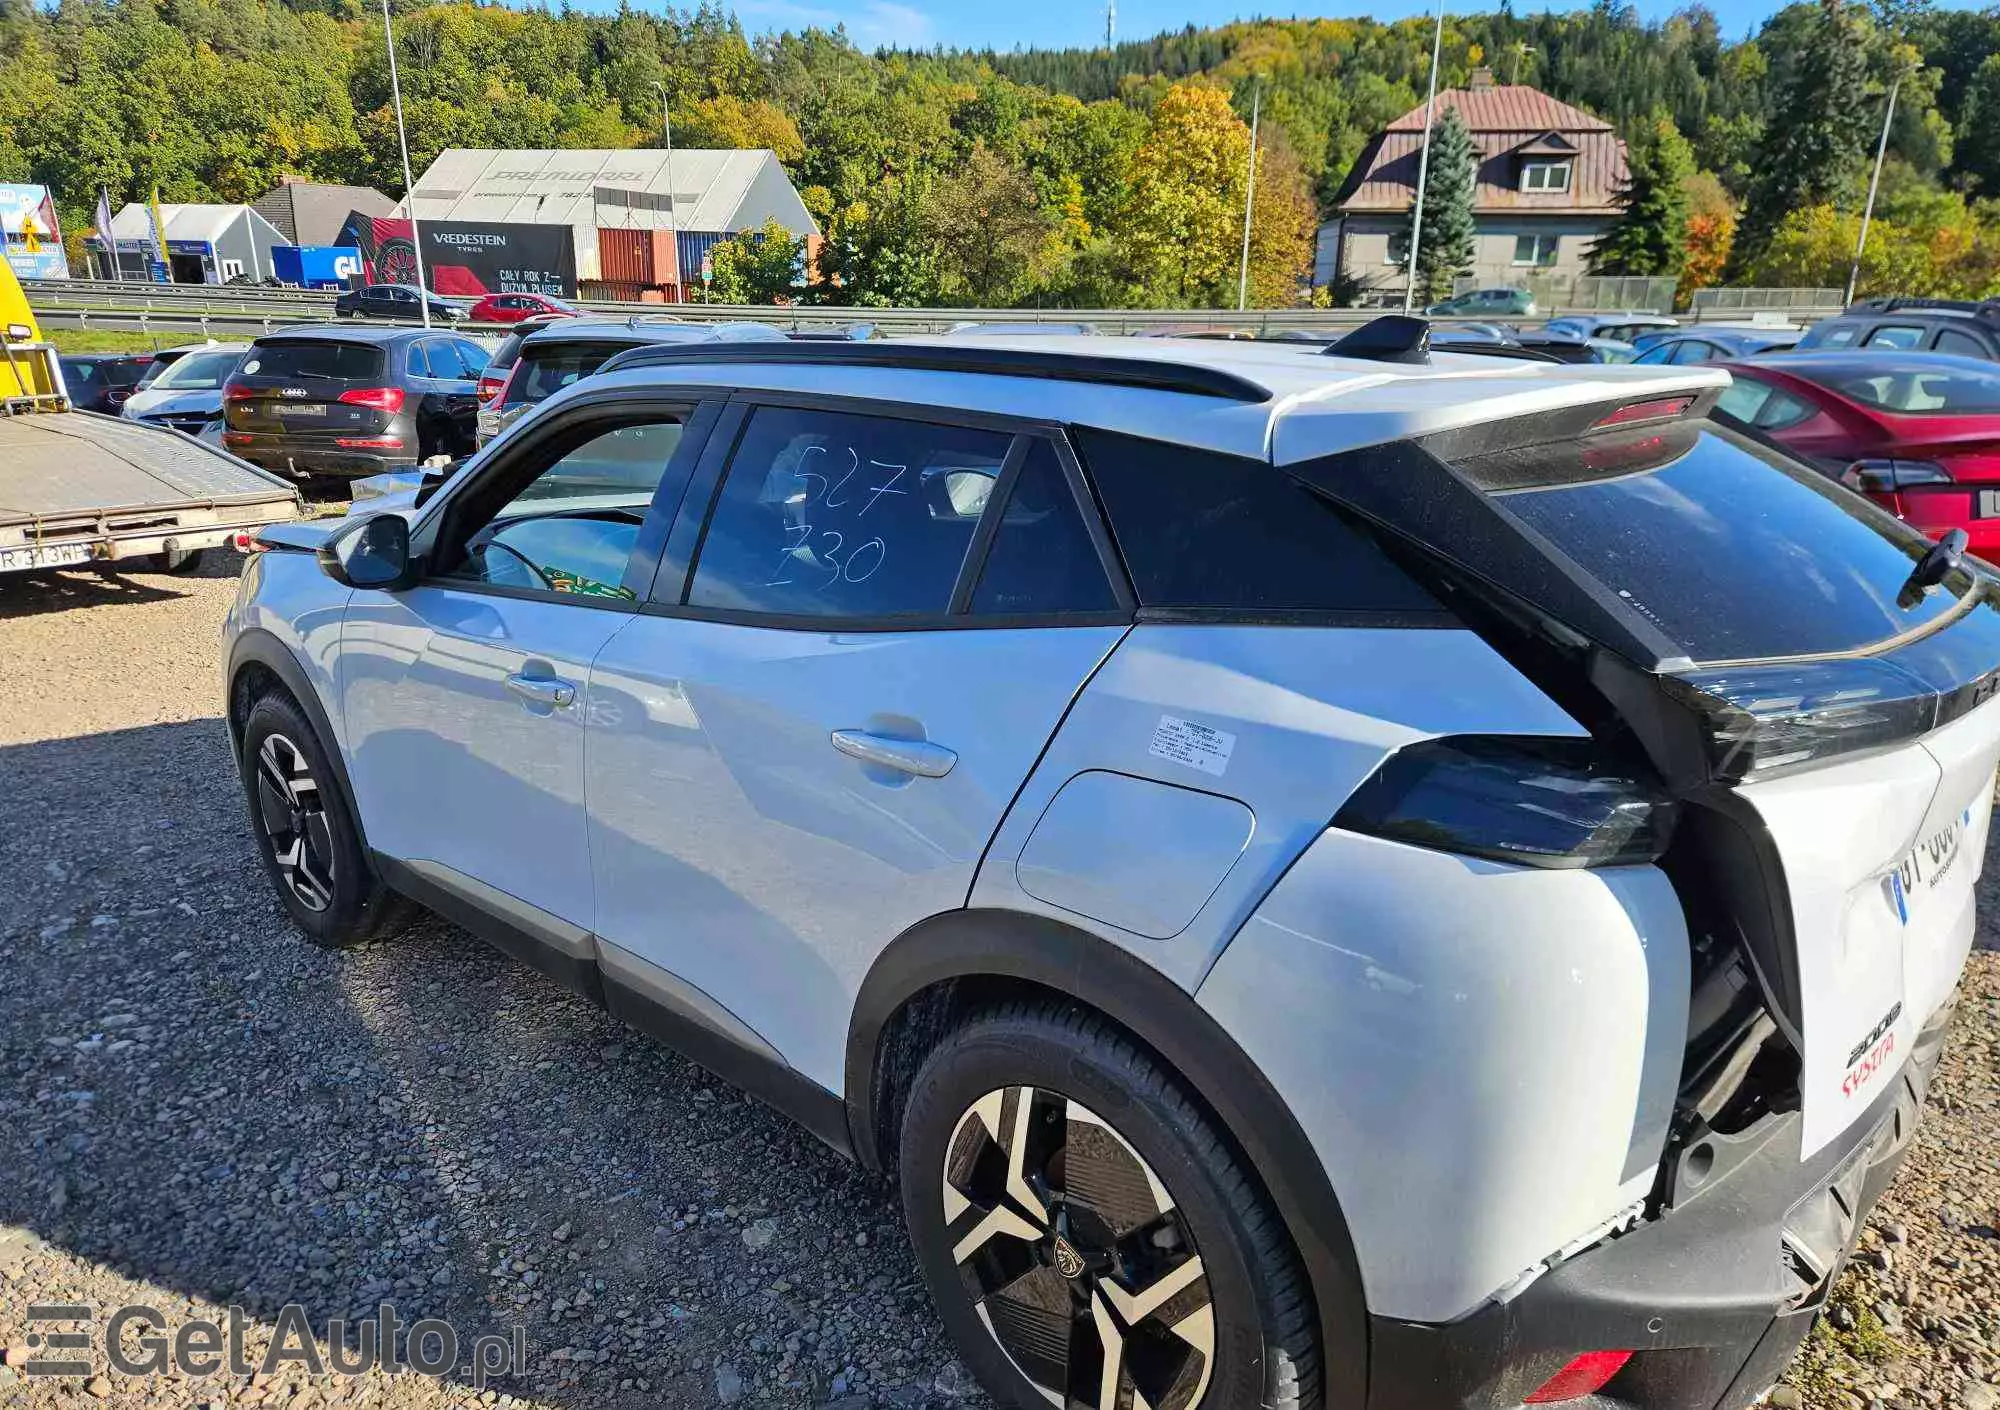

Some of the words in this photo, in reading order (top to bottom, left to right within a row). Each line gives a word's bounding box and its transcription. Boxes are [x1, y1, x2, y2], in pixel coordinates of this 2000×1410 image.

[433, 233, 506, 246] VREDESTEIN
[499, 270, 521, 282] CAŁY
[524, 271, 541, 282] ROK
[501, 282, 528, 294] DUŻYM
[531, 284, 563, 296] PLUSEM
[793, 446, 909, 517] 527
[1846, 1000, 1902, 1069] 2008
